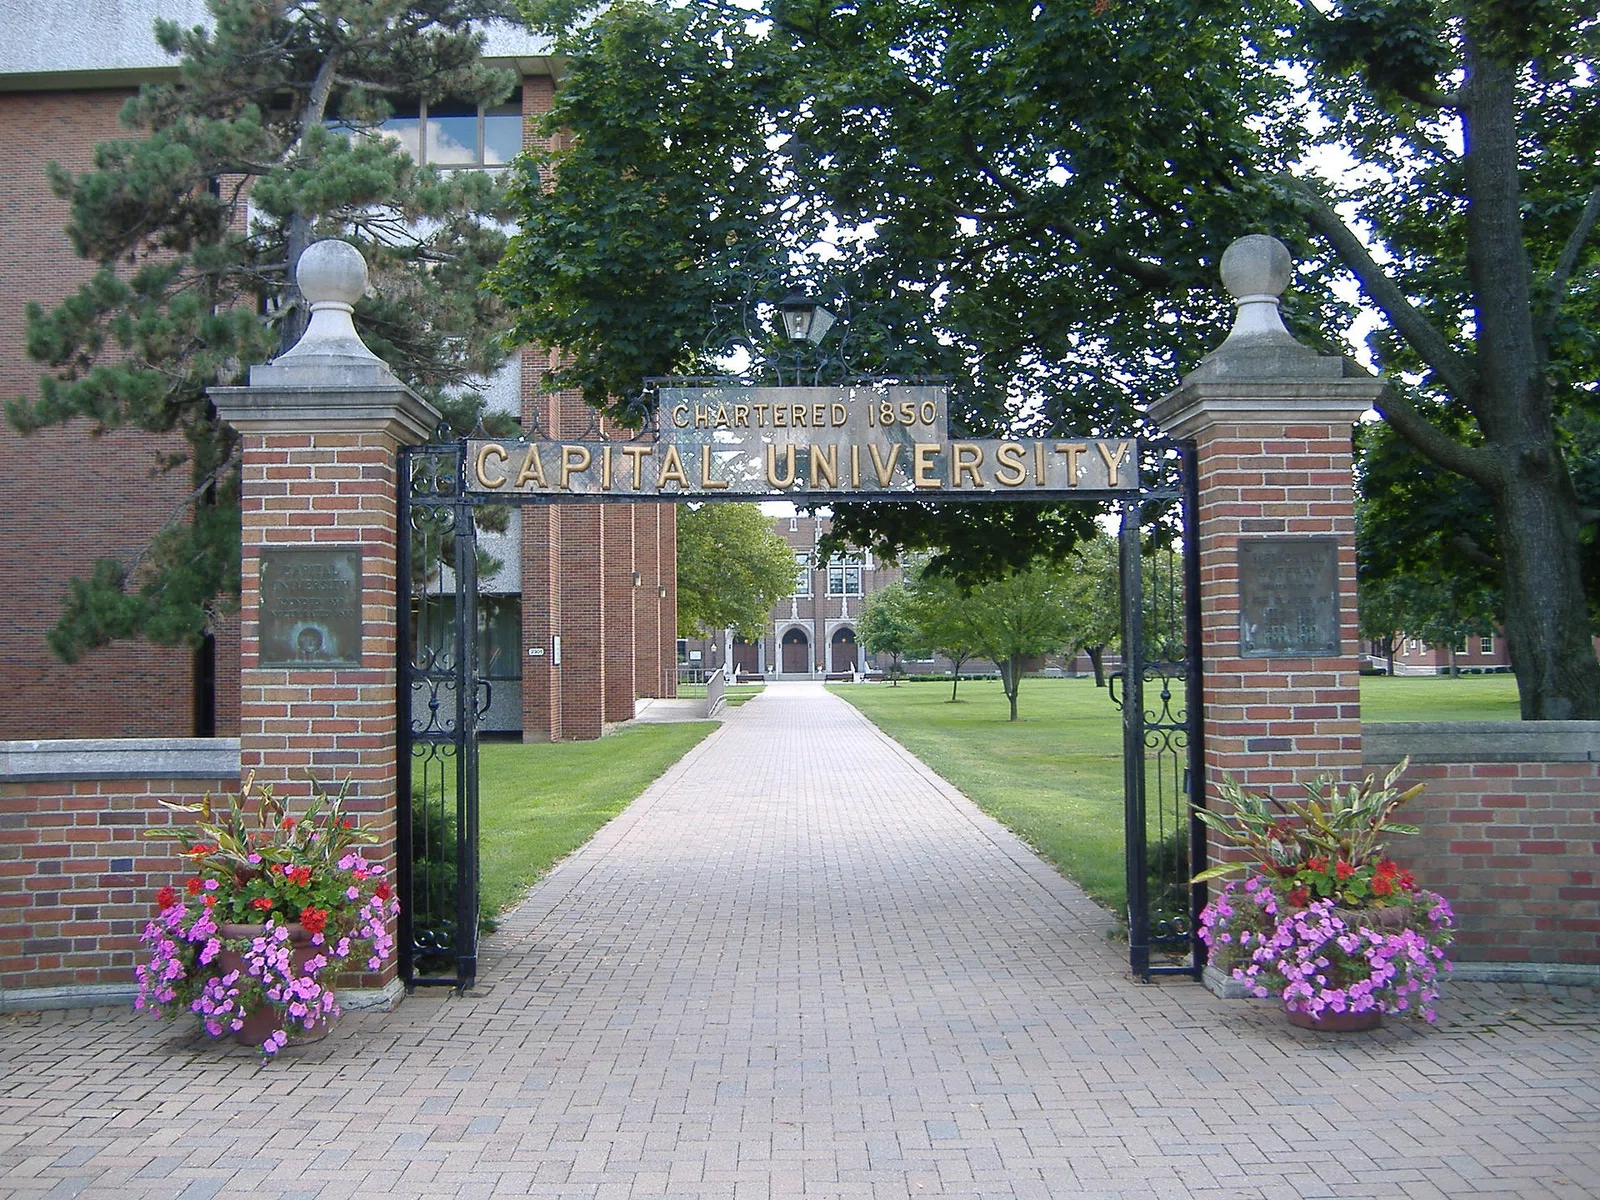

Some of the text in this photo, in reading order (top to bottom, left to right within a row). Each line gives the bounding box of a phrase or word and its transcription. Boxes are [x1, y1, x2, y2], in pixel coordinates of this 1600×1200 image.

[672, 400, 938, 428] CHARTERED 1850
[475, 441, 1129, 490] CAPITAL UNIVERSITY
